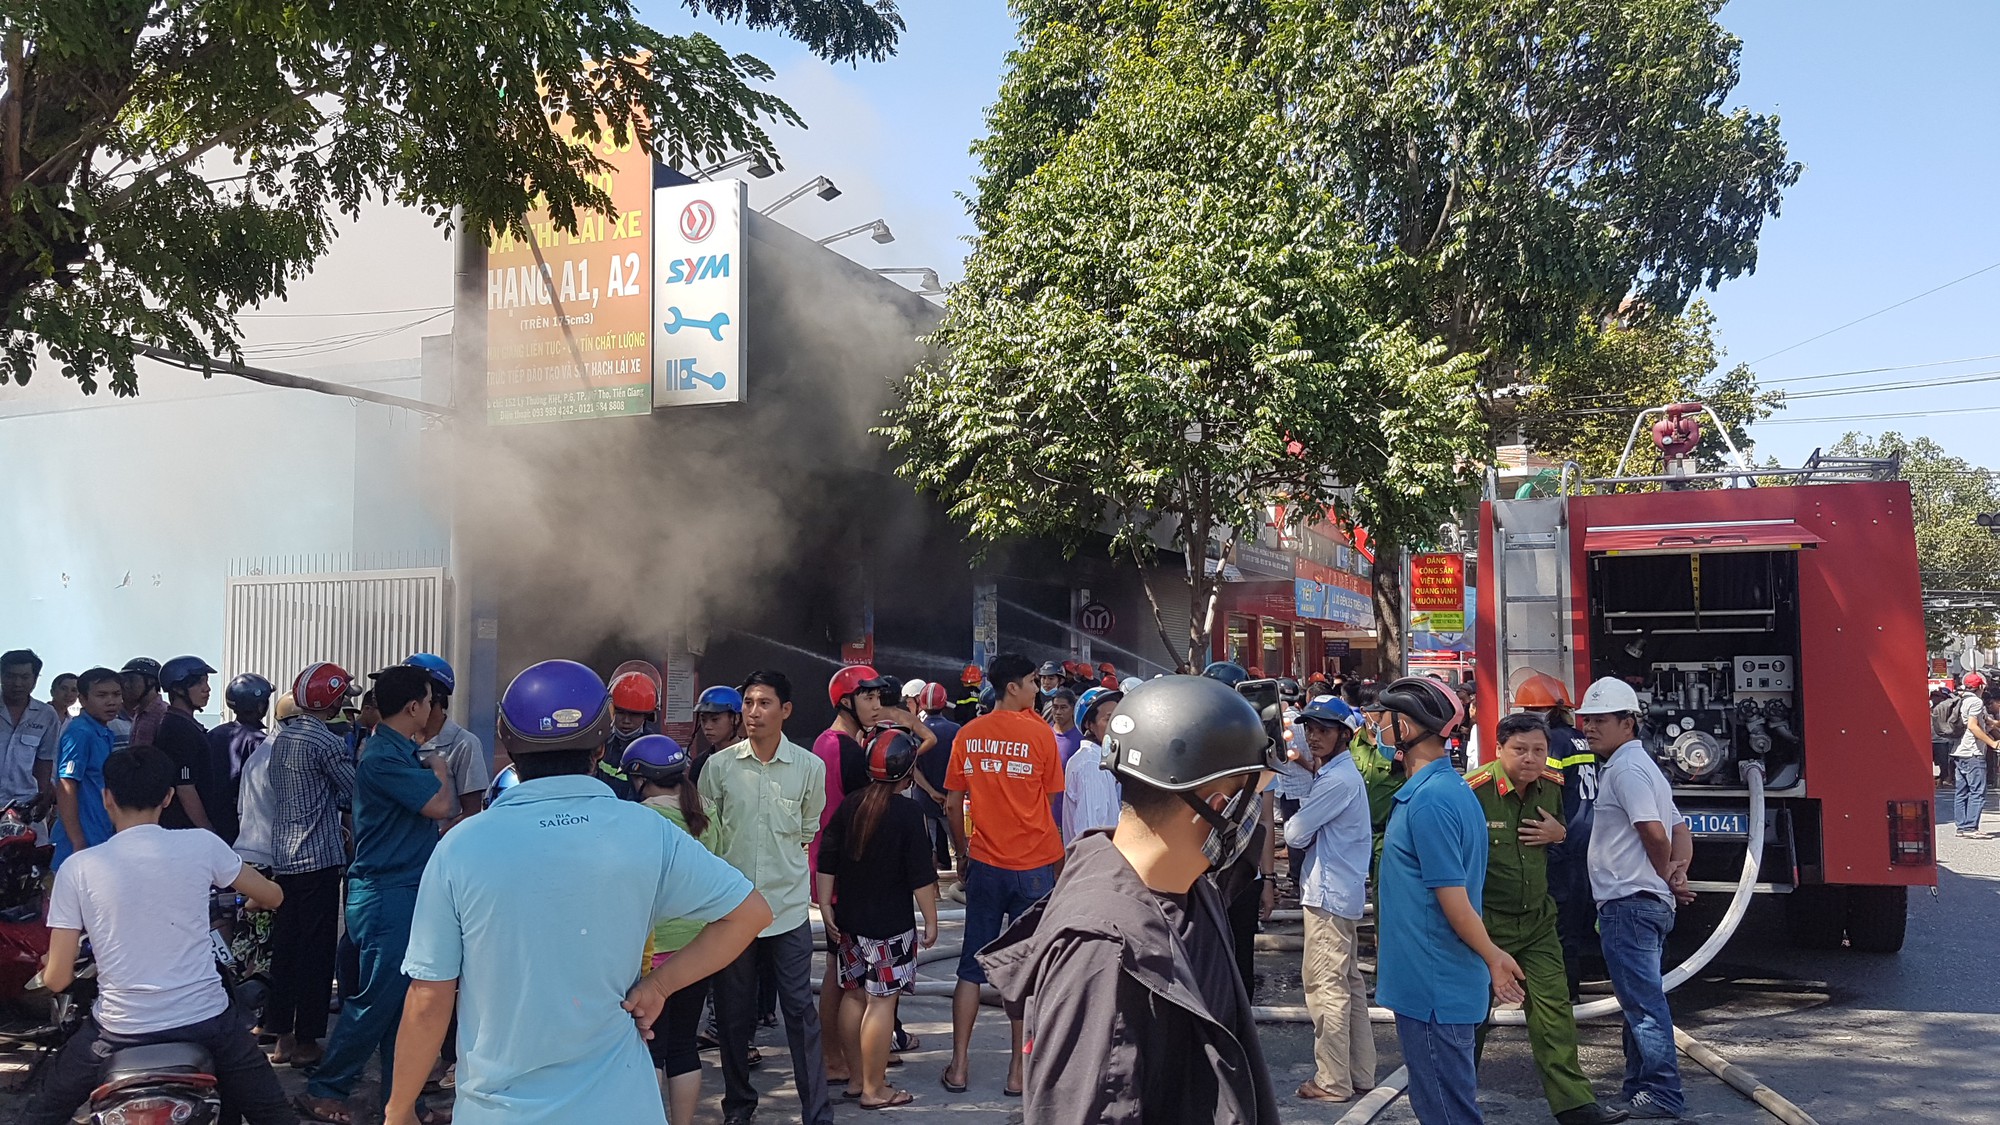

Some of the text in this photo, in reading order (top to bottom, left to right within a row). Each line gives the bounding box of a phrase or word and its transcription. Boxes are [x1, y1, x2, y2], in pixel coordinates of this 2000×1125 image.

[612, 210, 642, 240] XE
[666, 253, 729, 284] SYM
[488, 252, 640, 317] HẠNG A1, A2
[581, 334, 593, 352] TÍN
[595, 330, 616, 351] CHẤT
[619, 331, 645, 350] LƯỢNG
[591, 361, 613, 378] HẠCH
[615, 356, 628, 375] LÁI
[630, 358, 641, 374] XE
[1420, 577, 1434, 585] VIỆT
[966, 738, 1029, 758] VOLUNTEER
[539, 815, 590, 828] SAIGON
